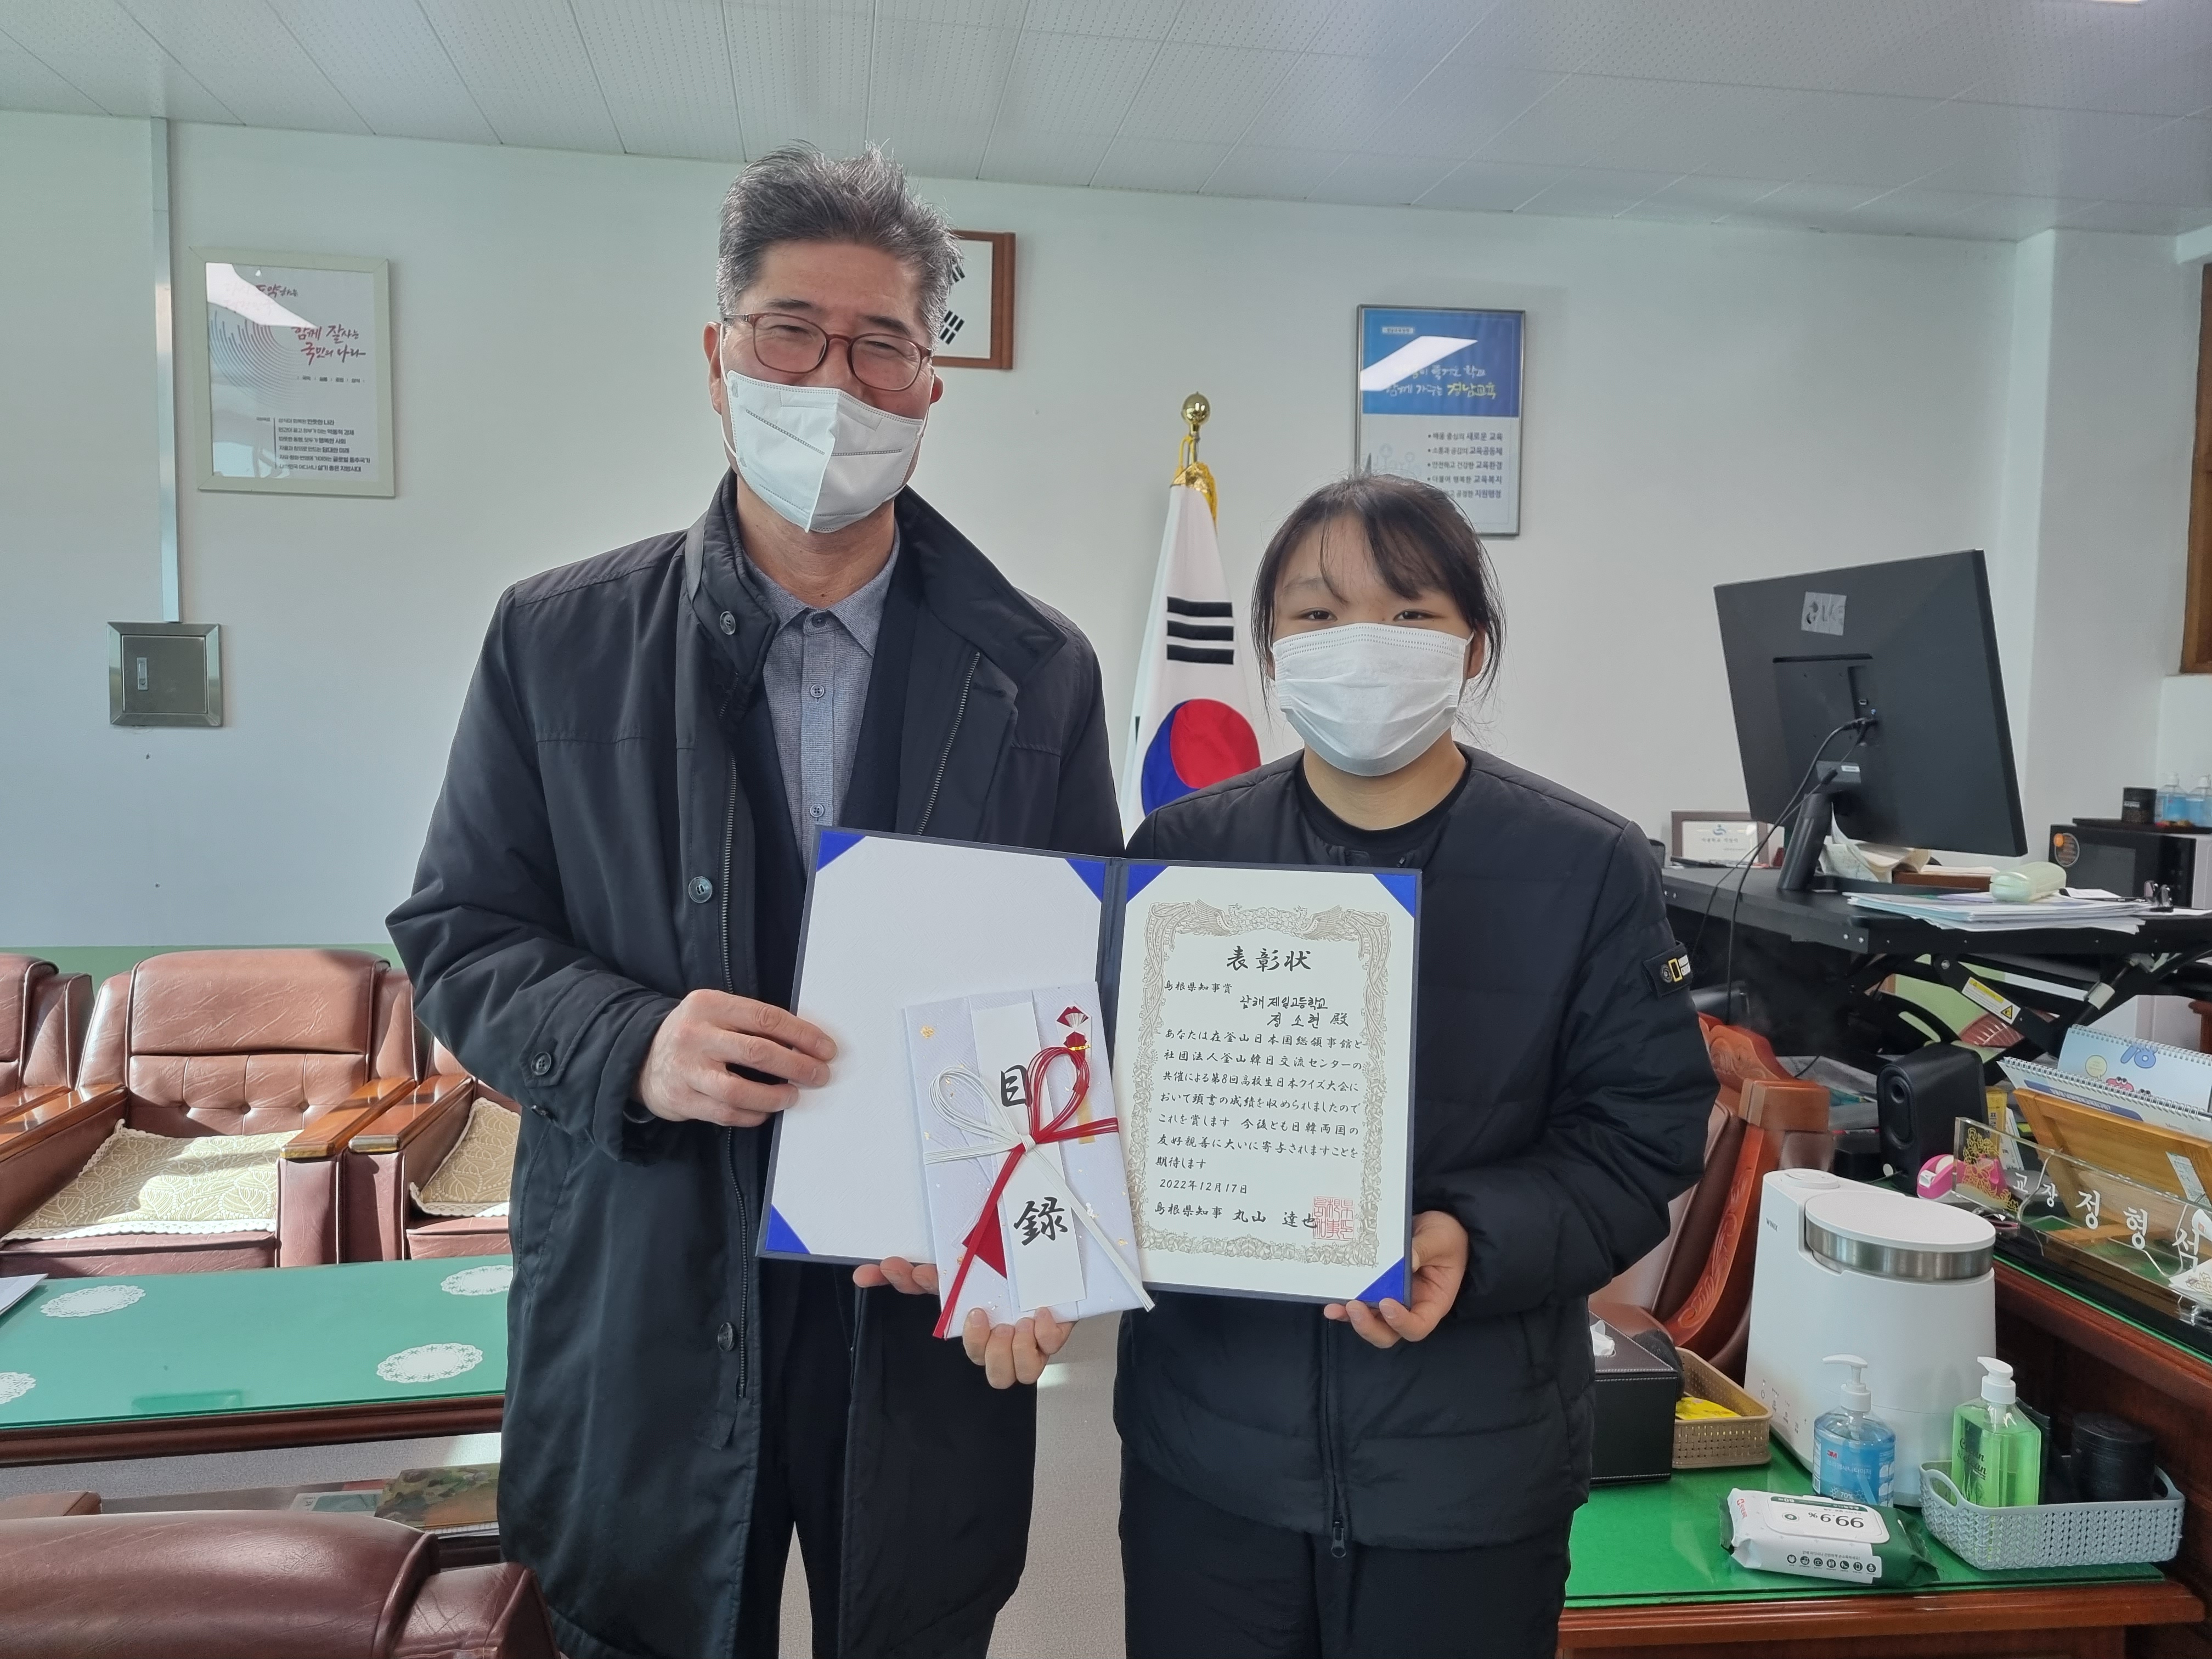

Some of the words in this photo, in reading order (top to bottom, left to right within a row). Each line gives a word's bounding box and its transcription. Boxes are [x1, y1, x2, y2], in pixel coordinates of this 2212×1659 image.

[326, 324, 359, 343] 잘사는
[301, 342, 332, 365] 국민의
[337, 345, 366, 363] 나라
[1464, 365, 1486, 379] 학교
[1447, 381, 1497, 399] 경남교육
[1227, 946, 1311, 972] 表彰状
[1165, 980, 1232, 994] 島根県知事賞
[1330, 1013, 1348, 1026] 殿
[1165, 1029, 1362, 1049] あなたは在釜山日本国総領事館と
[1164, 1049, 1362, 1070] 社団法人釜山韓日交流センターの
[1160, 1093, 1361, 1114] おいて頭書の成績を収められましたので
[1159, 1114, 1230, 1127] これを賞します
[1242, 1119, 1358, 1135] 今後とも日韓両国の
[1157, 1133, 1358, 1159] 友好親善に大いに寄与されますことを
[1156, 1156, 1205, 1169] 期待します
[1160, 1180, 1246, 1193] 2022年12月17日
[2014, 1172, 2058, 1207] 교장
[1155, 1202, 1222, 1218] 島根県知事
[1233, 1210, 1266, 1222] 丸山
[1283, 1211, 1317, 1228] 達也
[1765, 1217, 1778, 1232] WINIX
[1827, 1450, 1837, 1459] 3M
[1840, 1492, 1854, 1500] 70%
